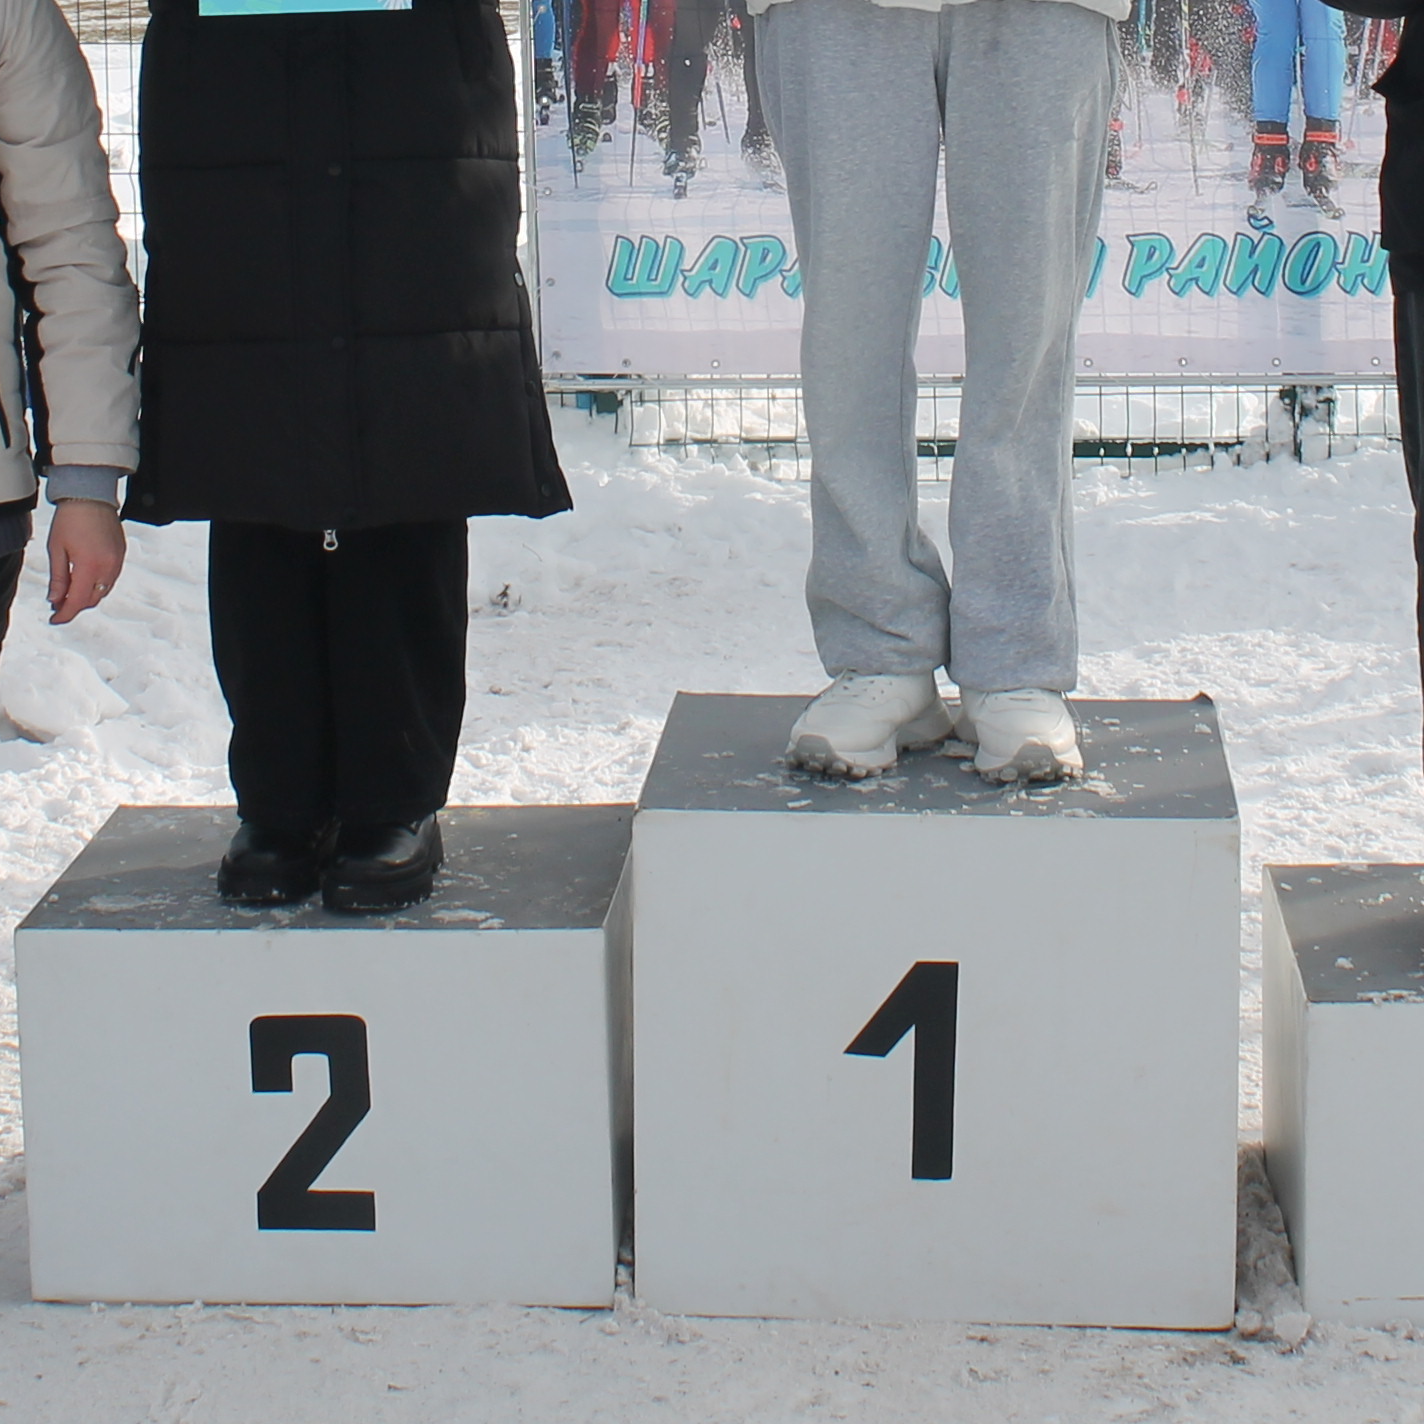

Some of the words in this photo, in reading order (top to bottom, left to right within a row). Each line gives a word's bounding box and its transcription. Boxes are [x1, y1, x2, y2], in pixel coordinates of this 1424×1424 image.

[1122, 214, 1390, 298] РАЙОН
[250, 1015, 375, 1231] 2
[844, 962, 958, 1180] 1
